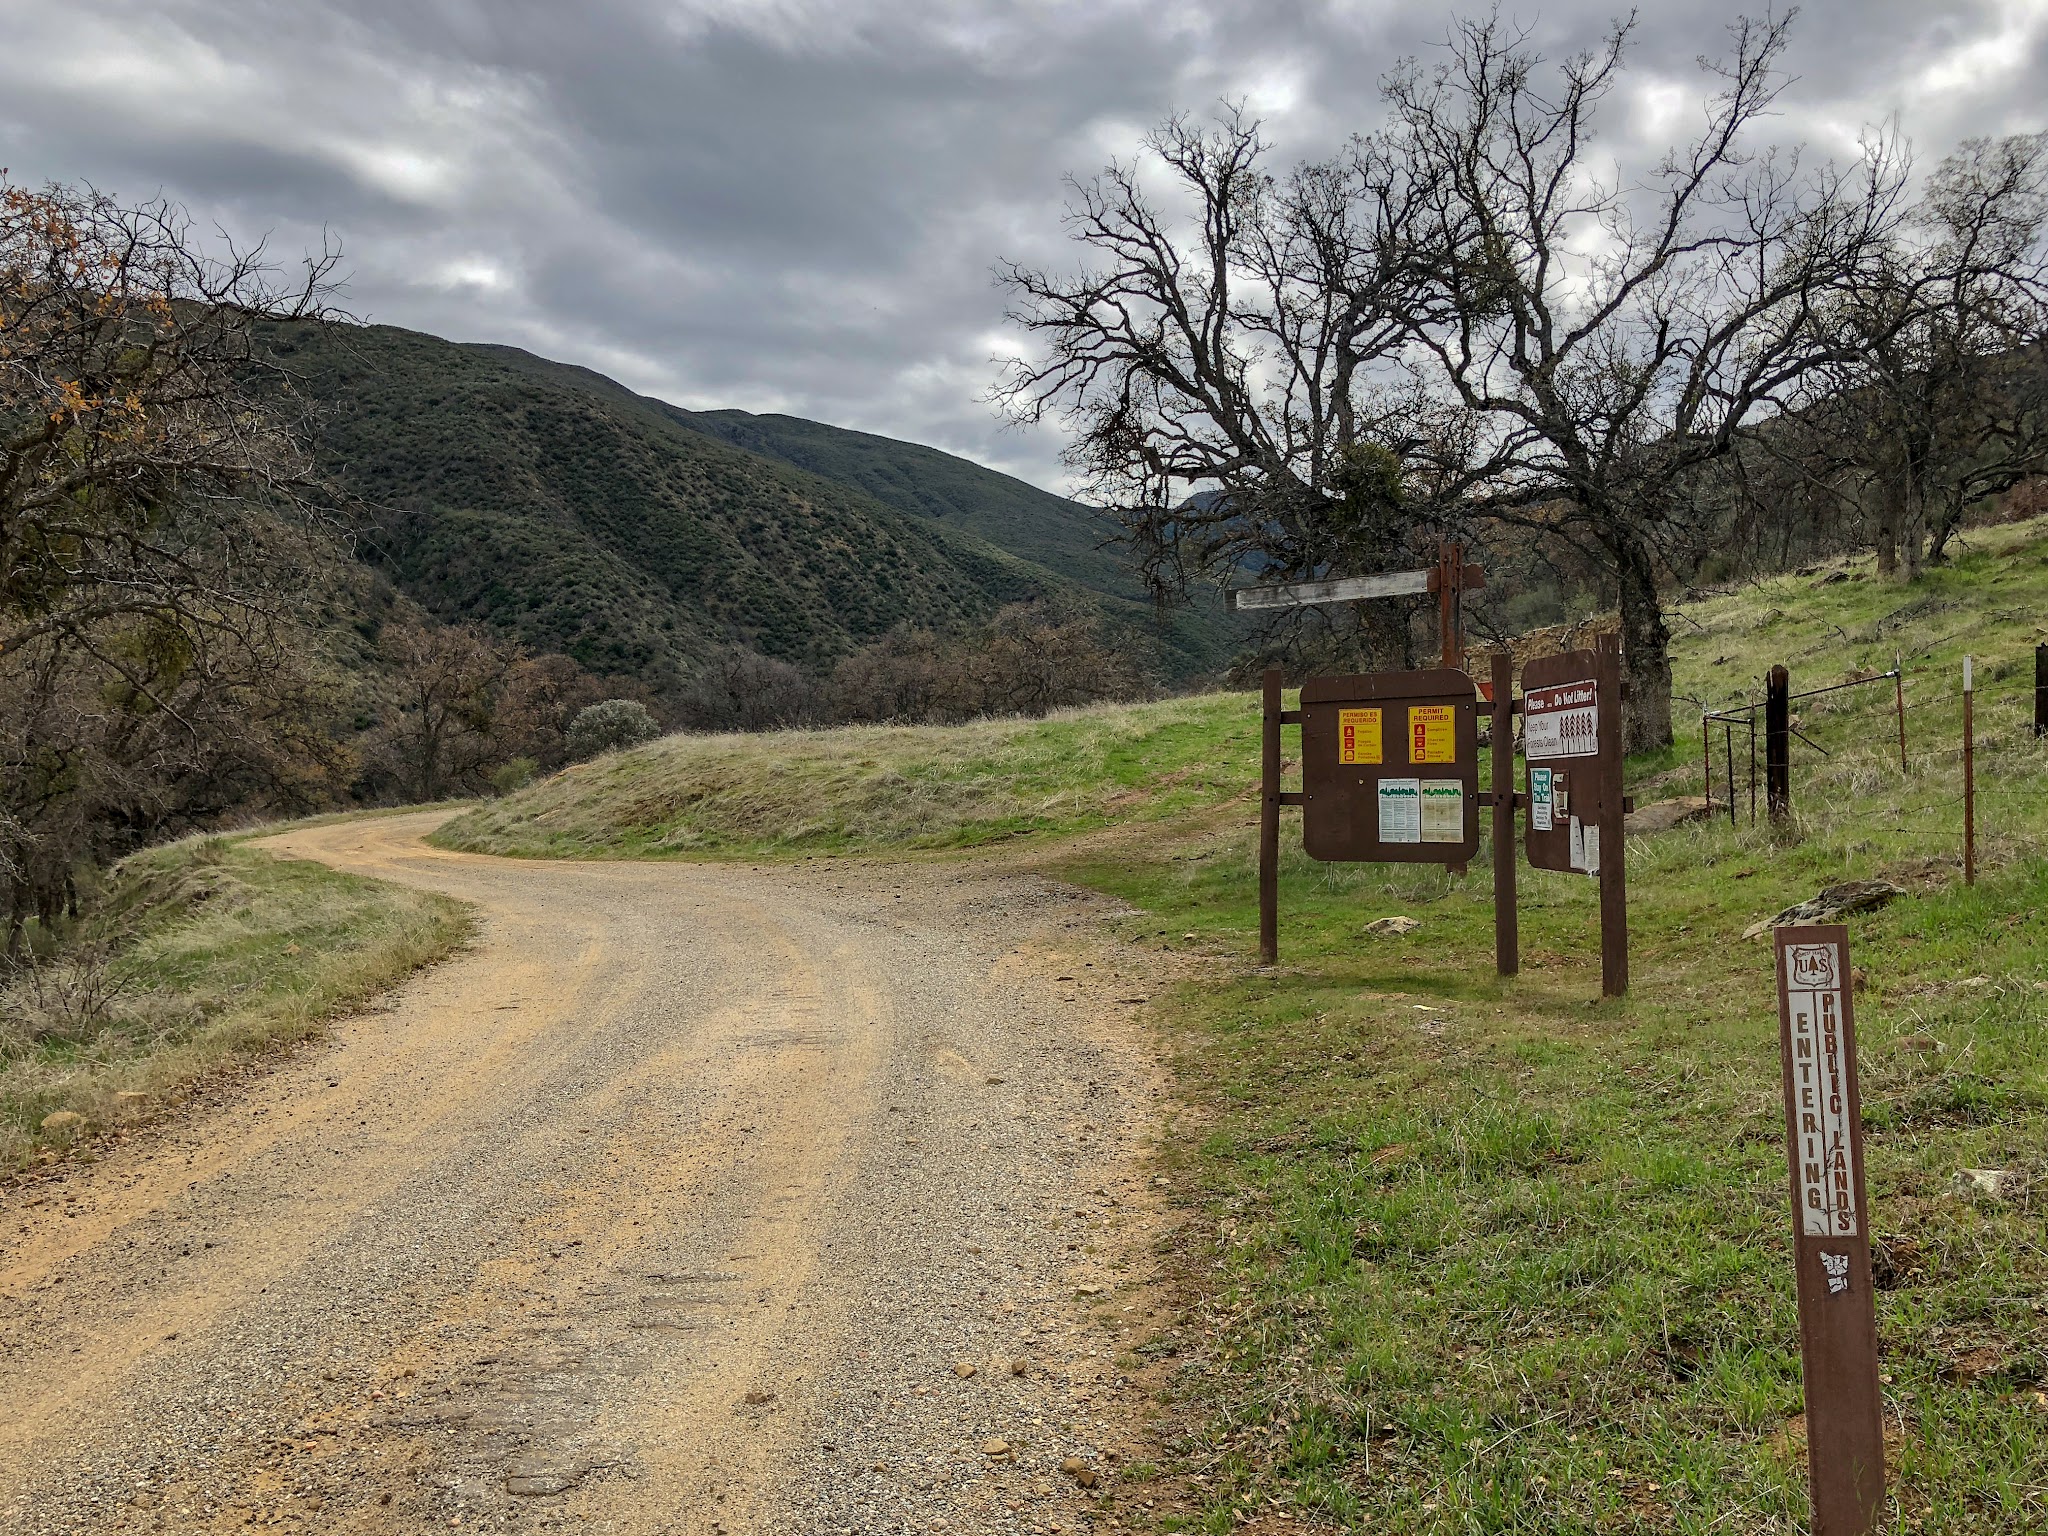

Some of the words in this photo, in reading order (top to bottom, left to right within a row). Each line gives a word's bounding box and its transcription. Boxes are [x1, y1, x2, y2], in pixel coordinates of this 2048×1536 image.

[1528, 698, 1544, 711] Please
[1554, 693, 1562, 707] Do
[1563, 691, 1573, 705] Not
[1573, 687, 1593, 703] Litter!
[1534, 772, 1547, 781] Please
[1533, 783, 1542, 792] Stay
[1542, 782, 1549, 792] On
[1541, 793, 1550, 802] Trail
[1796, 1012, 1822, 1211] ENTERING
[1822, 993, 1842, 1116] PUBLIC
[1832, 1129, 1852, 1232] LANDS
